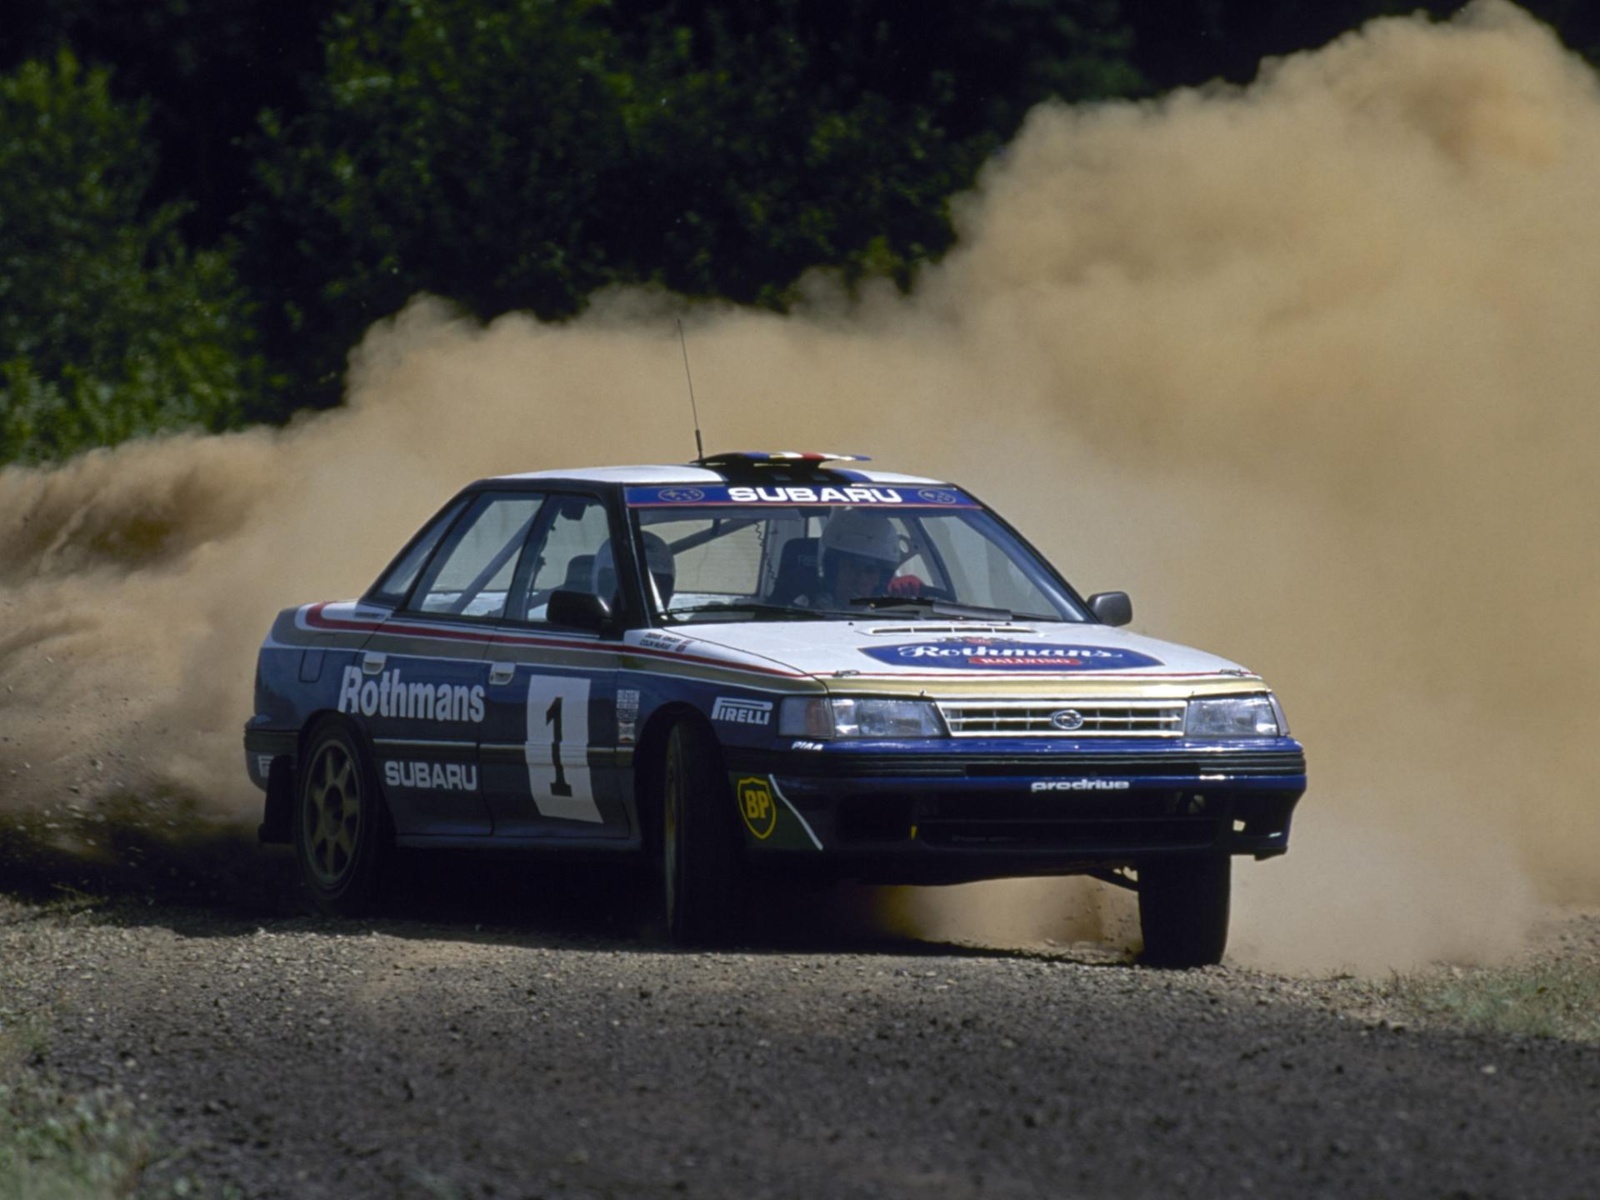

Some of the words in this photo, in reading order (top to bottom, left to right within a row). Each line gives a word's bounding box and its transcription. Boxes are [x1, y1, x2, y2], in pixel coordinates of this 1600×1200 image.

[728, 487, 902, 502] SUBARU
[898, 646, 1122, 657] Rothmans
[338, 665, 485, 722] Rothmans
[711, 696, 774, 725] PIRELLI
[546, 696, 573, 798] 1
[385, 761, 477, 791] SUBARU
[1031, 779, 1129, 792] prodrive
[745, 790, 770, 818] BP
